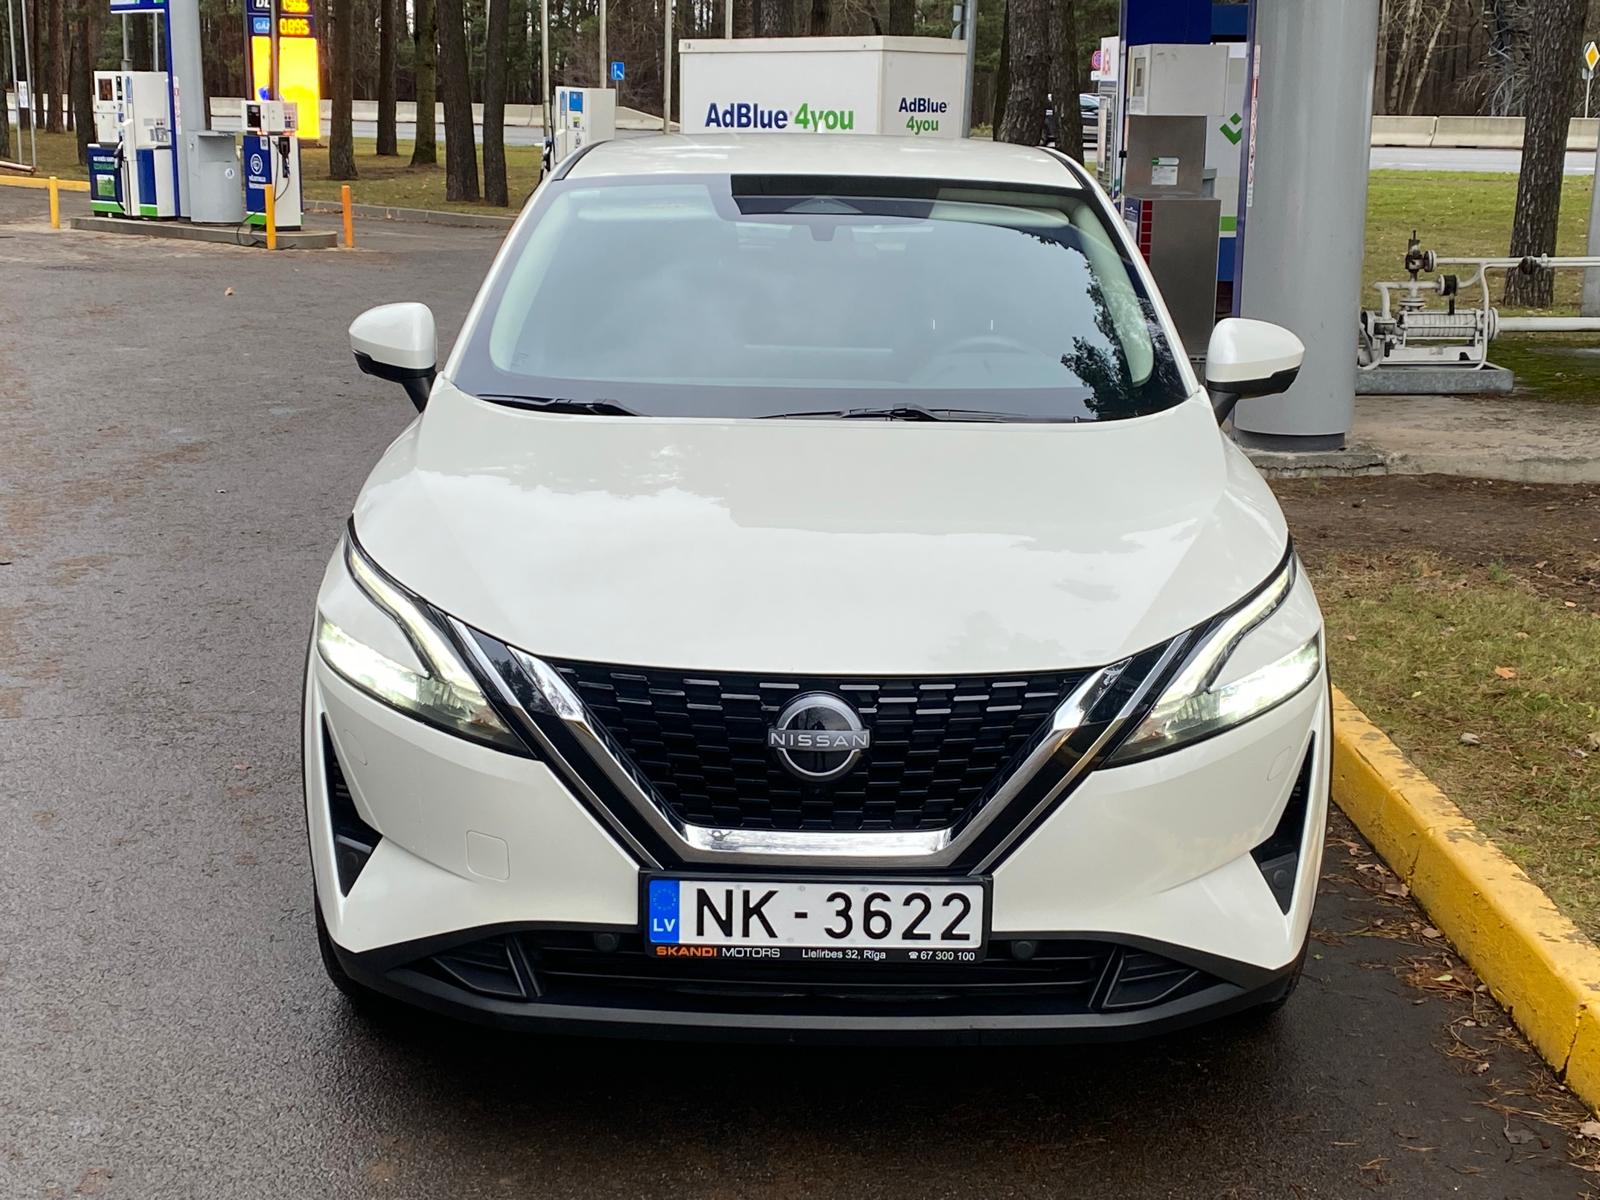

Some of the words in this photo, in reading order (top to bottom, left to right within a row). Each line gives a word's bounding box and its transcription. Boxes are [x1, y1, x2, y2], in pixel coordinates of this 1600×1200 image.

[898, 97, 948, 113] AdBlue
[705, 103, 788, 129] AdBlue
[794, 103, 854, 132] 4you
[906, 116, 939, 135] 4you
[770, 732, 867, 747] NISSAN
[653, 918, 676, 932] LV
[656, 946, 717, 957] SKANDI
[722, 947, 781, 958] MOTORS
[920, 951, 933, 961] 67
[935, 951, 954, 961] 300
[957, 951, 976, 962] 100
